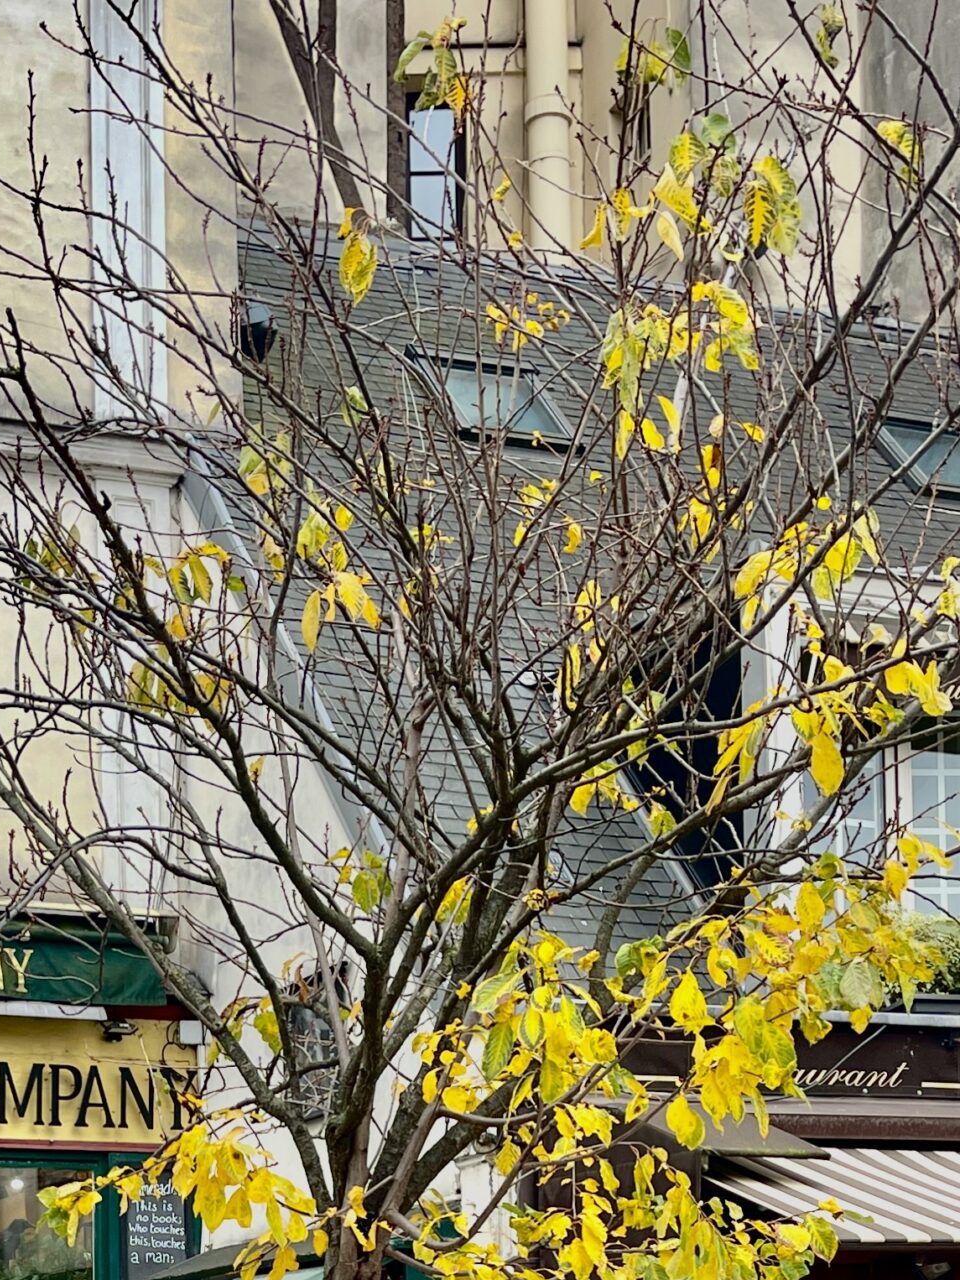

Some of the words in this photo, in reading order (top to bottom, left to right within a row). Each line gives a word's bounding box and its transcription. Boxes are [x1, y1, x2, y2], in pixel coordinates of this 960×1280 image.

[133, 1200, 157, 1213] This
[162, 1200, 173, 1212] is
[136, 1213, 148, 1223] no
[128, 1223, 148, 1233] Who
[150, 1223, 185, 1236] touches
[151, 1235, 186, 1250] touches
[130, 1253, 140, 1264] a
